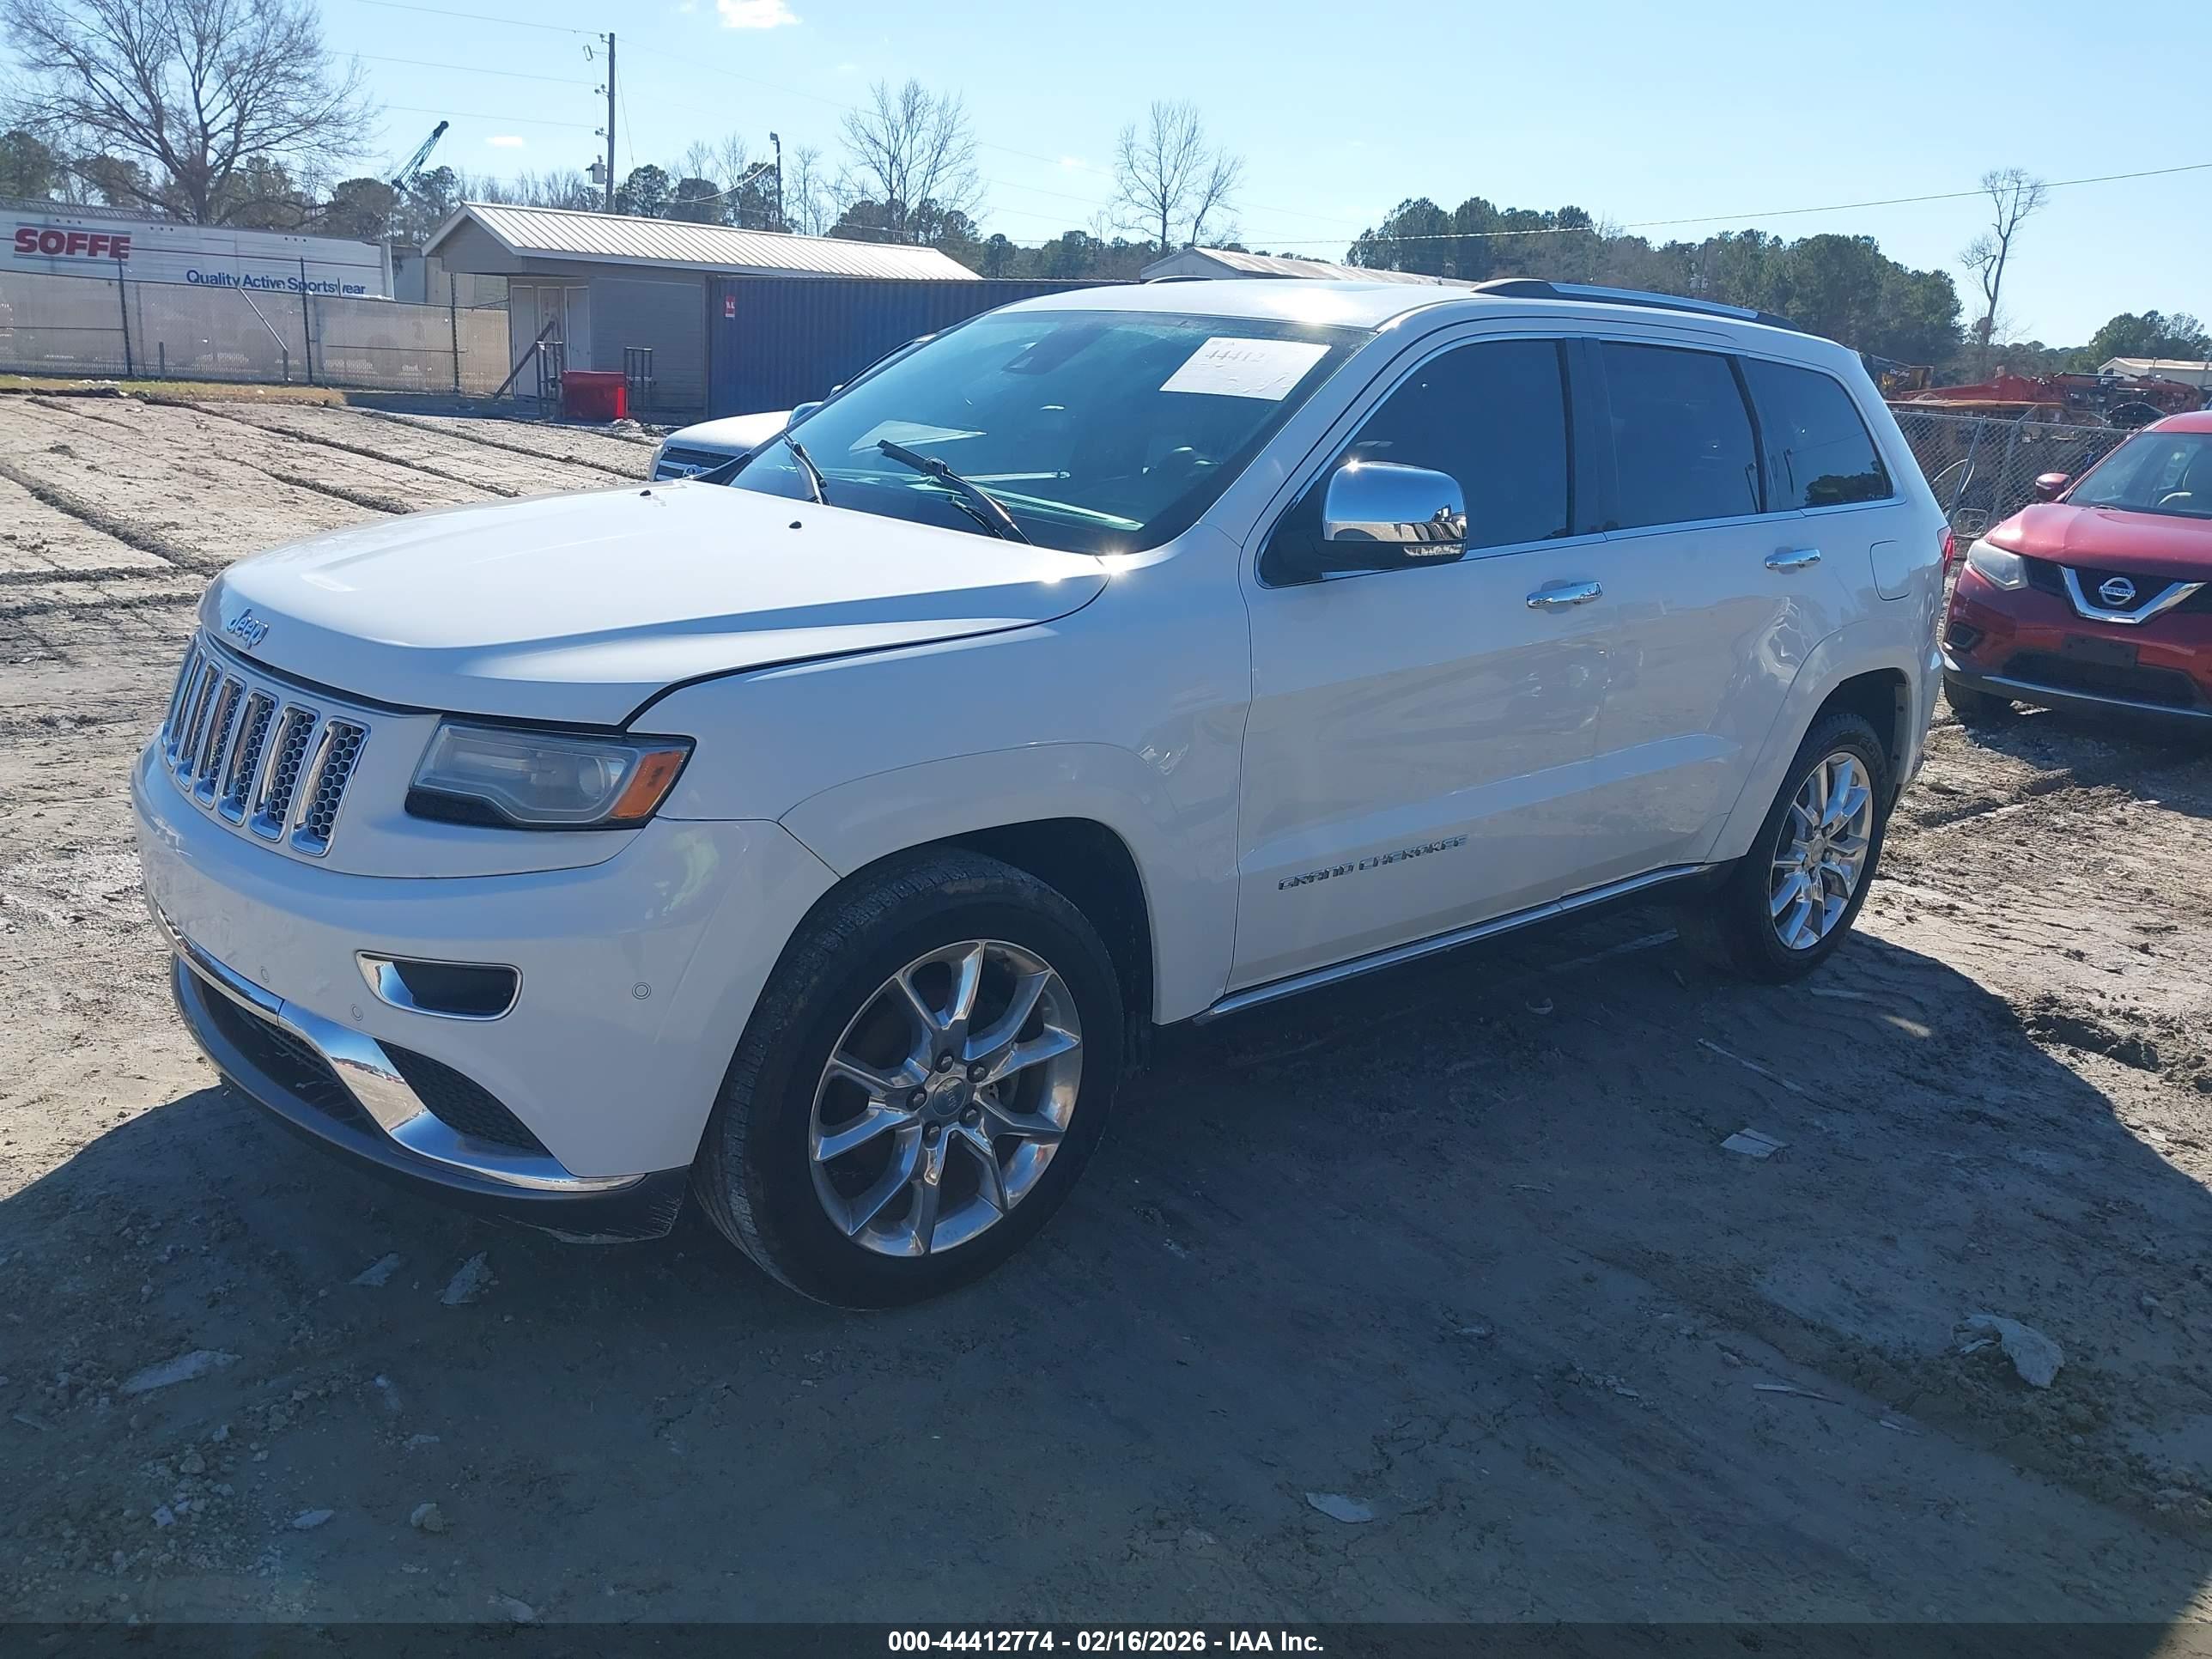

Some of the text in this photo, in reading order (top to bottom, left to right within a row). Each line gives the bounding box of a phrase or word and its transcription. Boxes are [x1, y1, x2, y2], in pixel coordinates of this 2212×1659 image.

[14, 228, 131, 259] SOFFE
[186, 270, 240, 287] Quality
[243, 274, 286, 289] Active
[2101, 586, 2132, 595] NISSAN
[227, 607, 269, 650] Jeep
[1278, 833, 1470, 890] GRAND CHEROKEE
